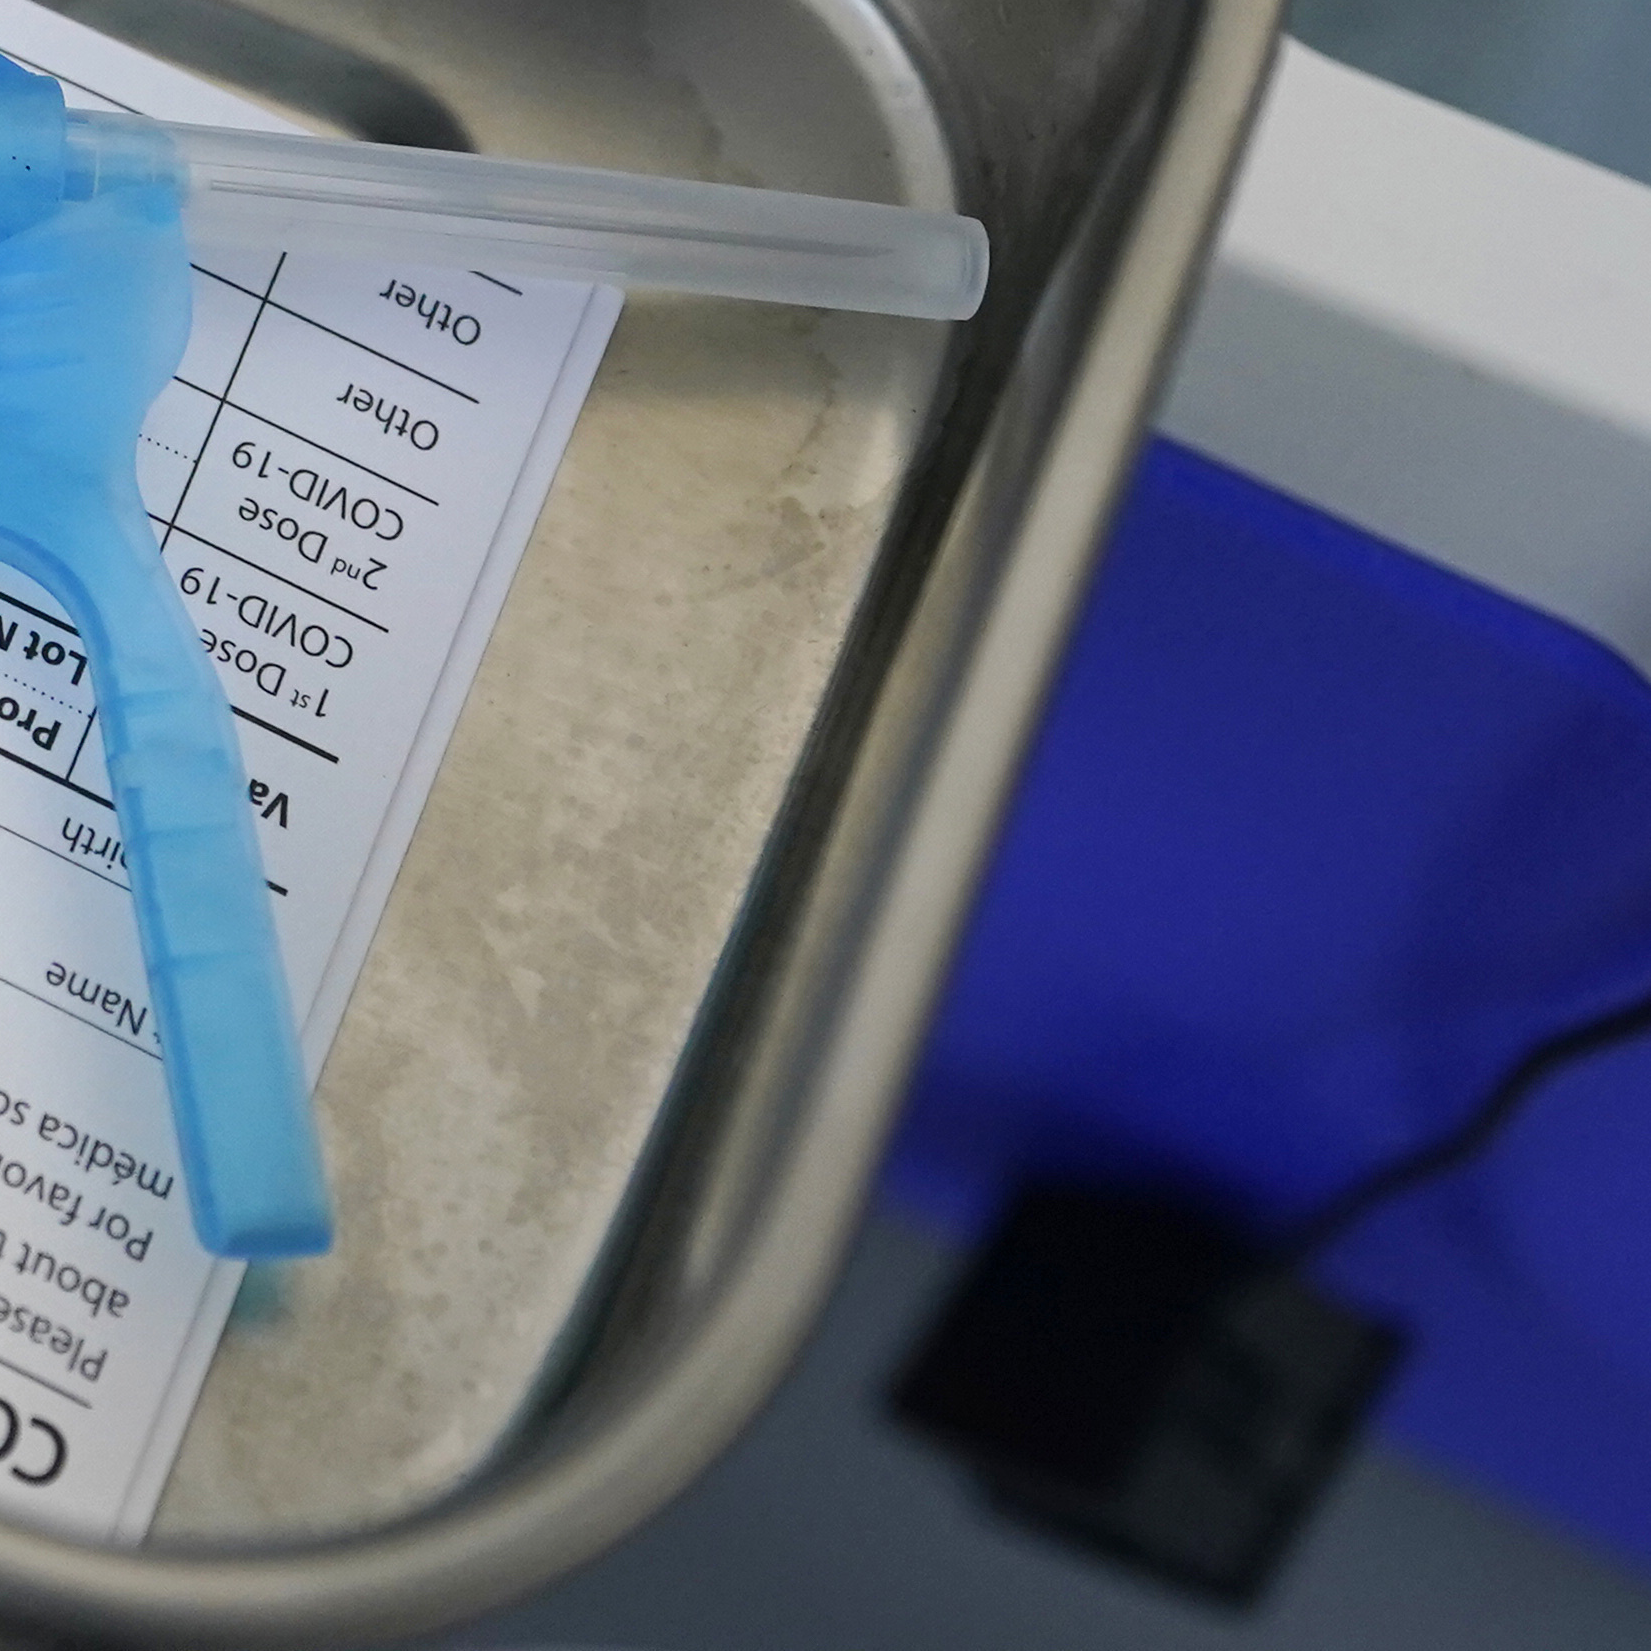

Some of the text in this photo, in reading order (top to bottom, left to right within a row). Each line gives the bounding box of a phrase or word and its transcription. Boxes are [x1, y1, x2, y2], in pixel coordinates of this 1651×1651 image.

[380, 280, 480, 345] Other
[337, 384, 438, 450] Other
[233, 442, 402, 540] COVID-19
[239, 498, 386, 589] 2nd Dose
[181, 568, 352, 667] COVID-19
[22, 629, 91, 686] Lot
[199, 630, 328, 717] 1st Dose
[61, 816, 133, 876] irth
[47, 962, 146, 1035] Name
[38, 1113, 173, 1199] médica
[88, 1207, 152, 1261] Por
[14, 1243, 129, 1317] about
